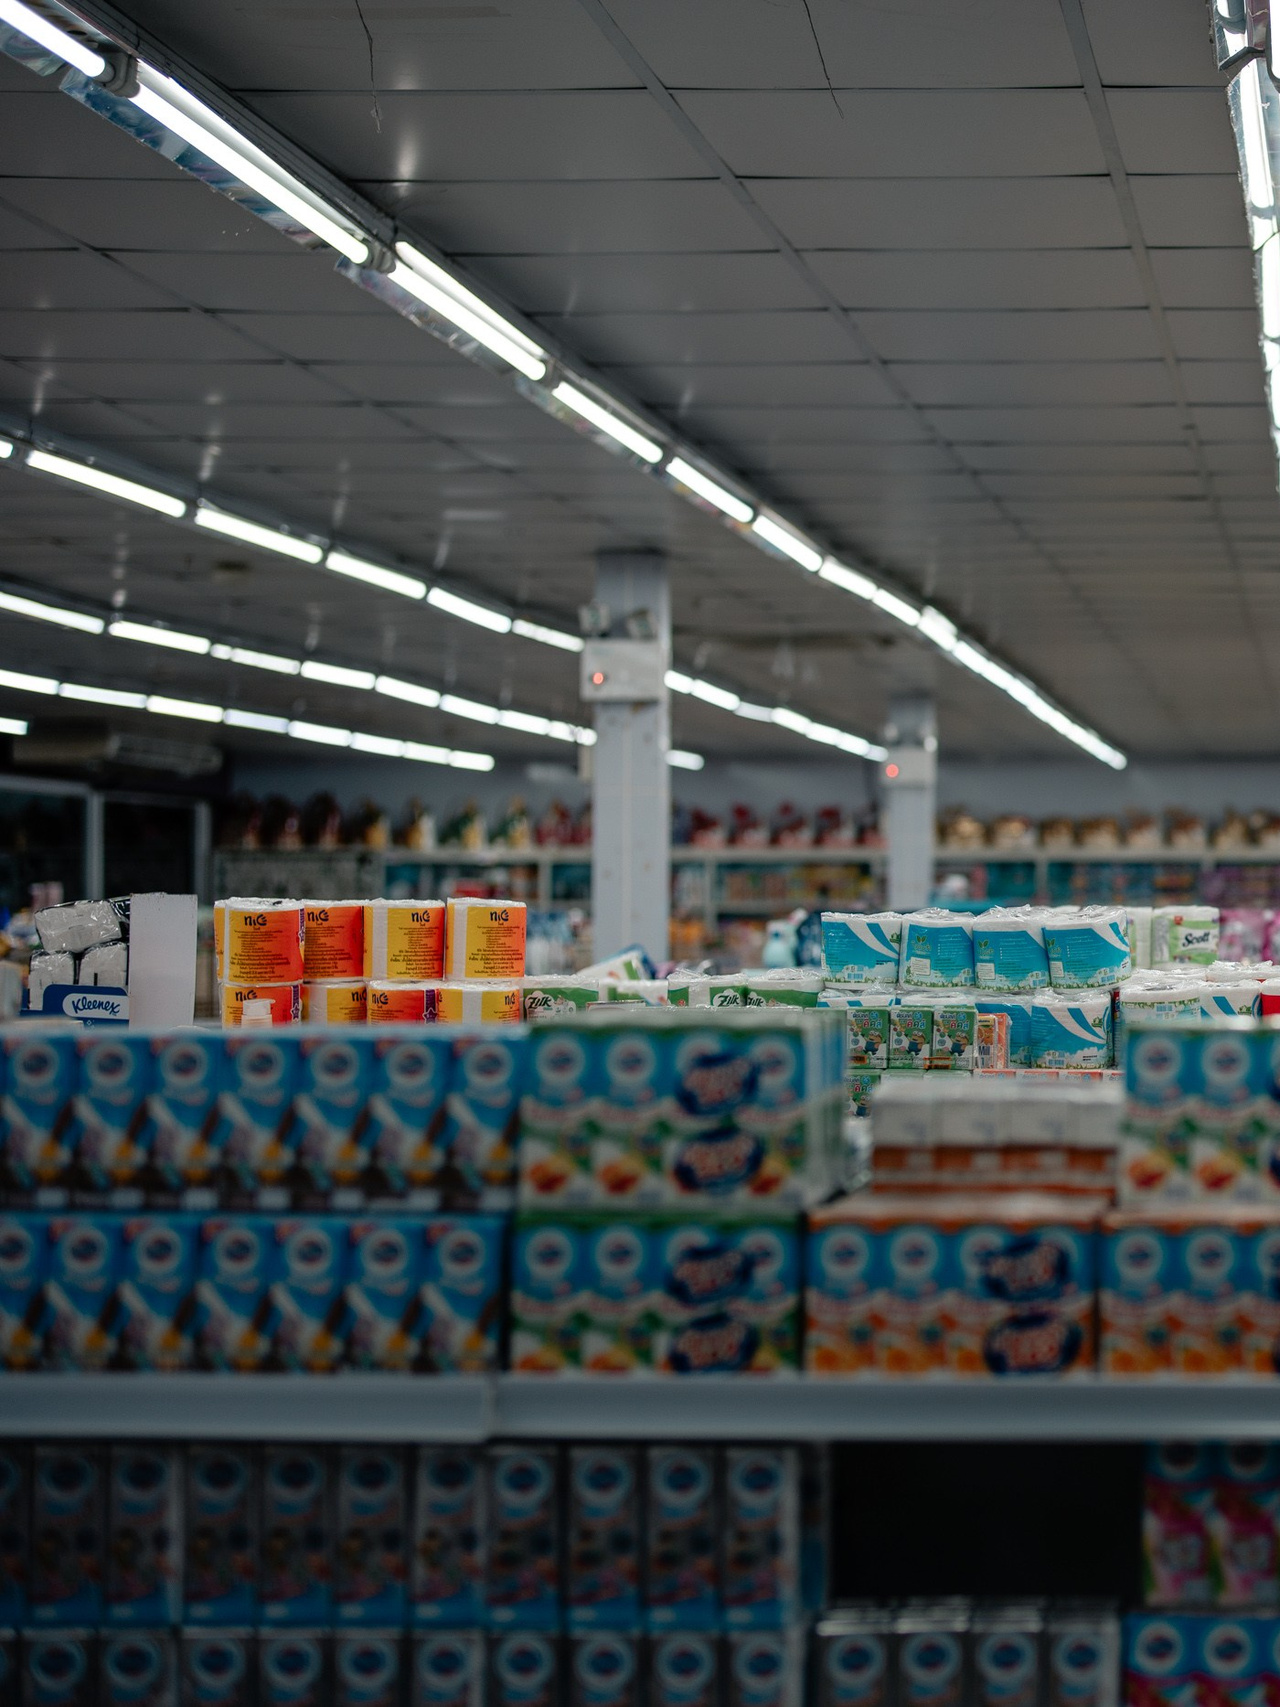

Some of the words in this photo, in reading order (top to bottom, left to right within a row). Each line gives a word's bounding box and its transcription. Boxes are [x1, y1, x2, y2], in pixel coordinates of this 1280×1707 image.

[1182, 932, 1210, 947] Scott
[72, 996, 120, 1014] Kleenex
[528, 996, 551, 1009] Zilk
[718, 994, 739, 1007] Zilk
